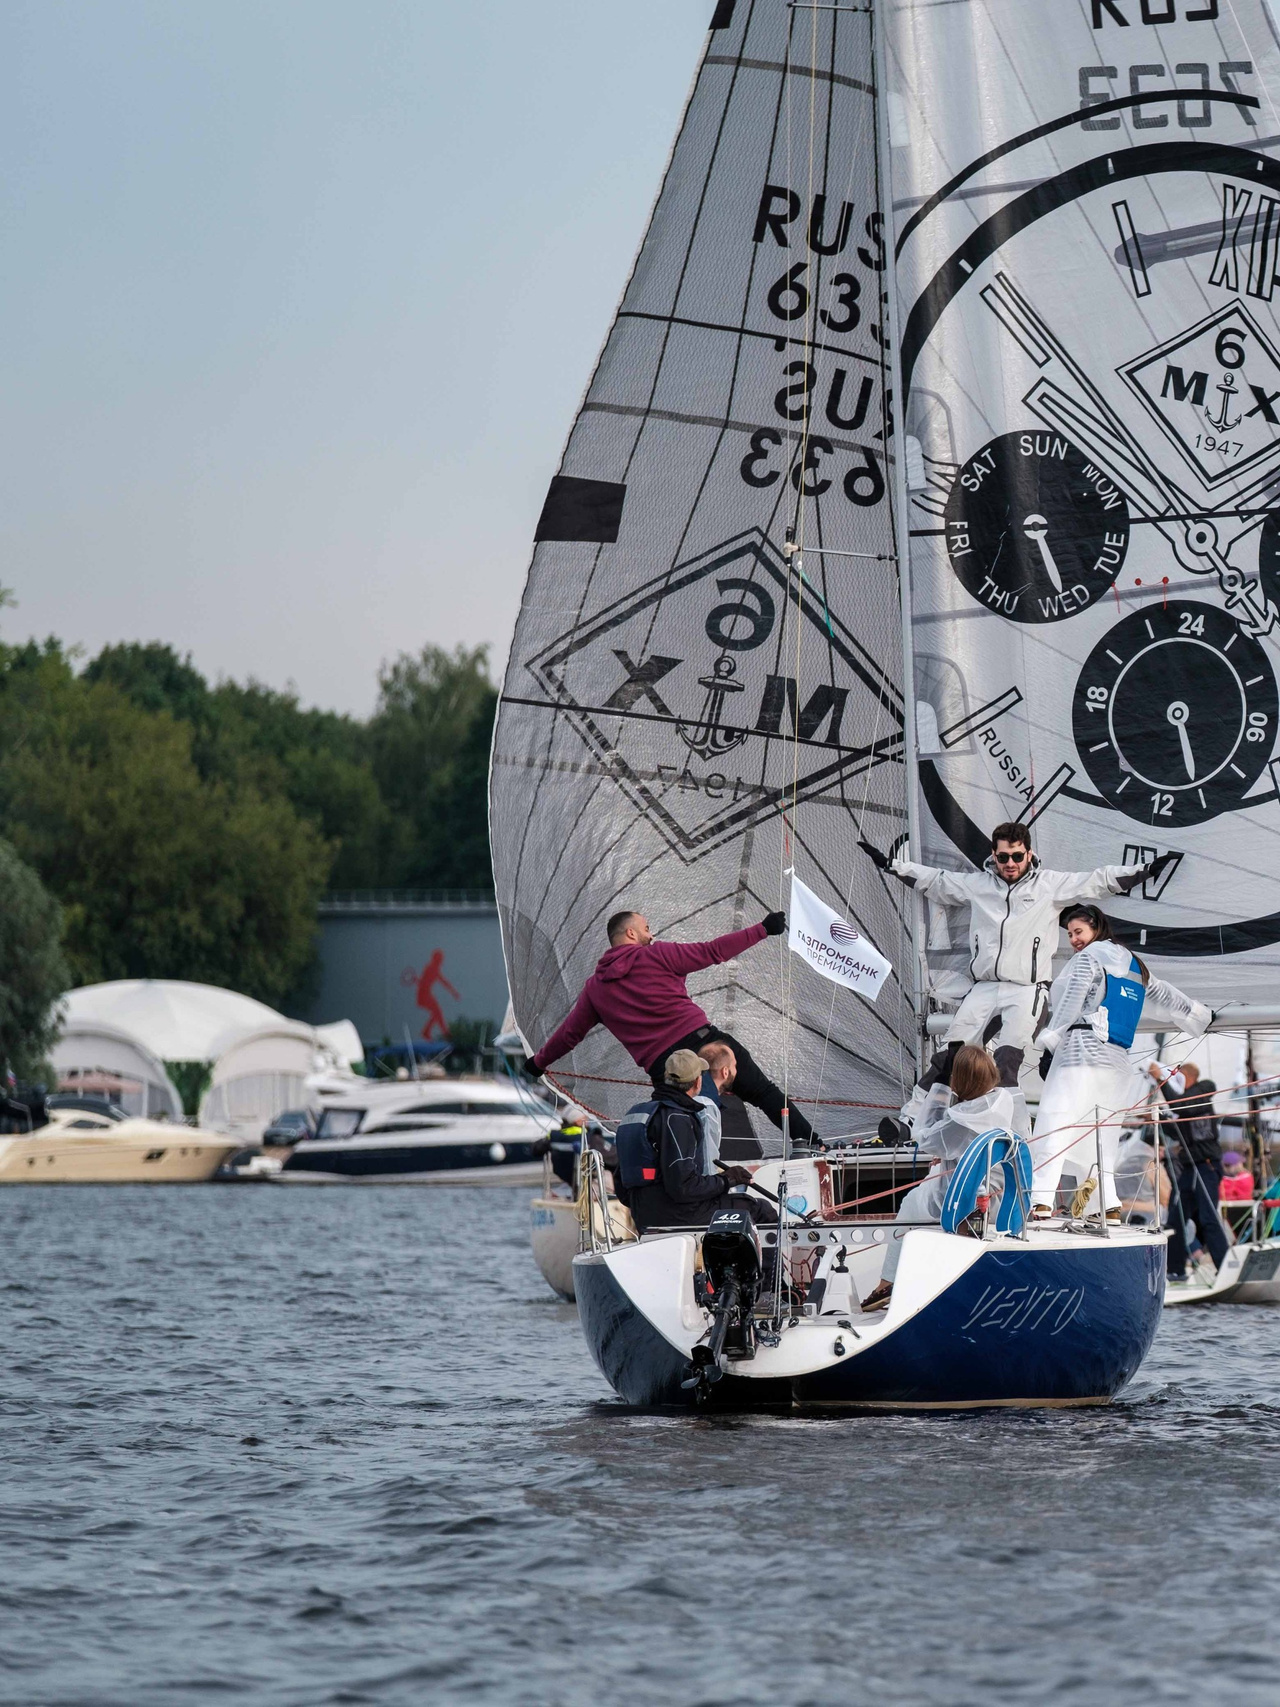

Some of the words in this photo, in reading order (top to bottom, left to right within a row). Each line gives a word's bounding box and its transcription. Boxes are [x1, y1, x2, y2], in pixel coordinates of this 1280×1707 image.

[1215, 327, 1248, 370] 6
[1160, 364, 1209, 406] M
[1020, 435, 1068, 460] SUN
[1195, 433, 1244, 458] 1947
[960, 448, 998, 492] SAT
[1081, 463, 1122, 511] MON
[949, 521, 975, 558] FRI
[1093, 532, 1125, 575] TUE
[977, 575, 1019, 614] THU
[1038, 584, 1090, 618] WED
[1178, 612, 1205, 636] 24
[1085, 686, 1109, 712] 18
[978, 727, 1036, 802] RUSSIA
[1151, 792, 1175, 816] 12
[797, 929, 879, 979] ГАЗПРОМБАНК
[806, 948, 860, 982] ПРЕМИУМ
